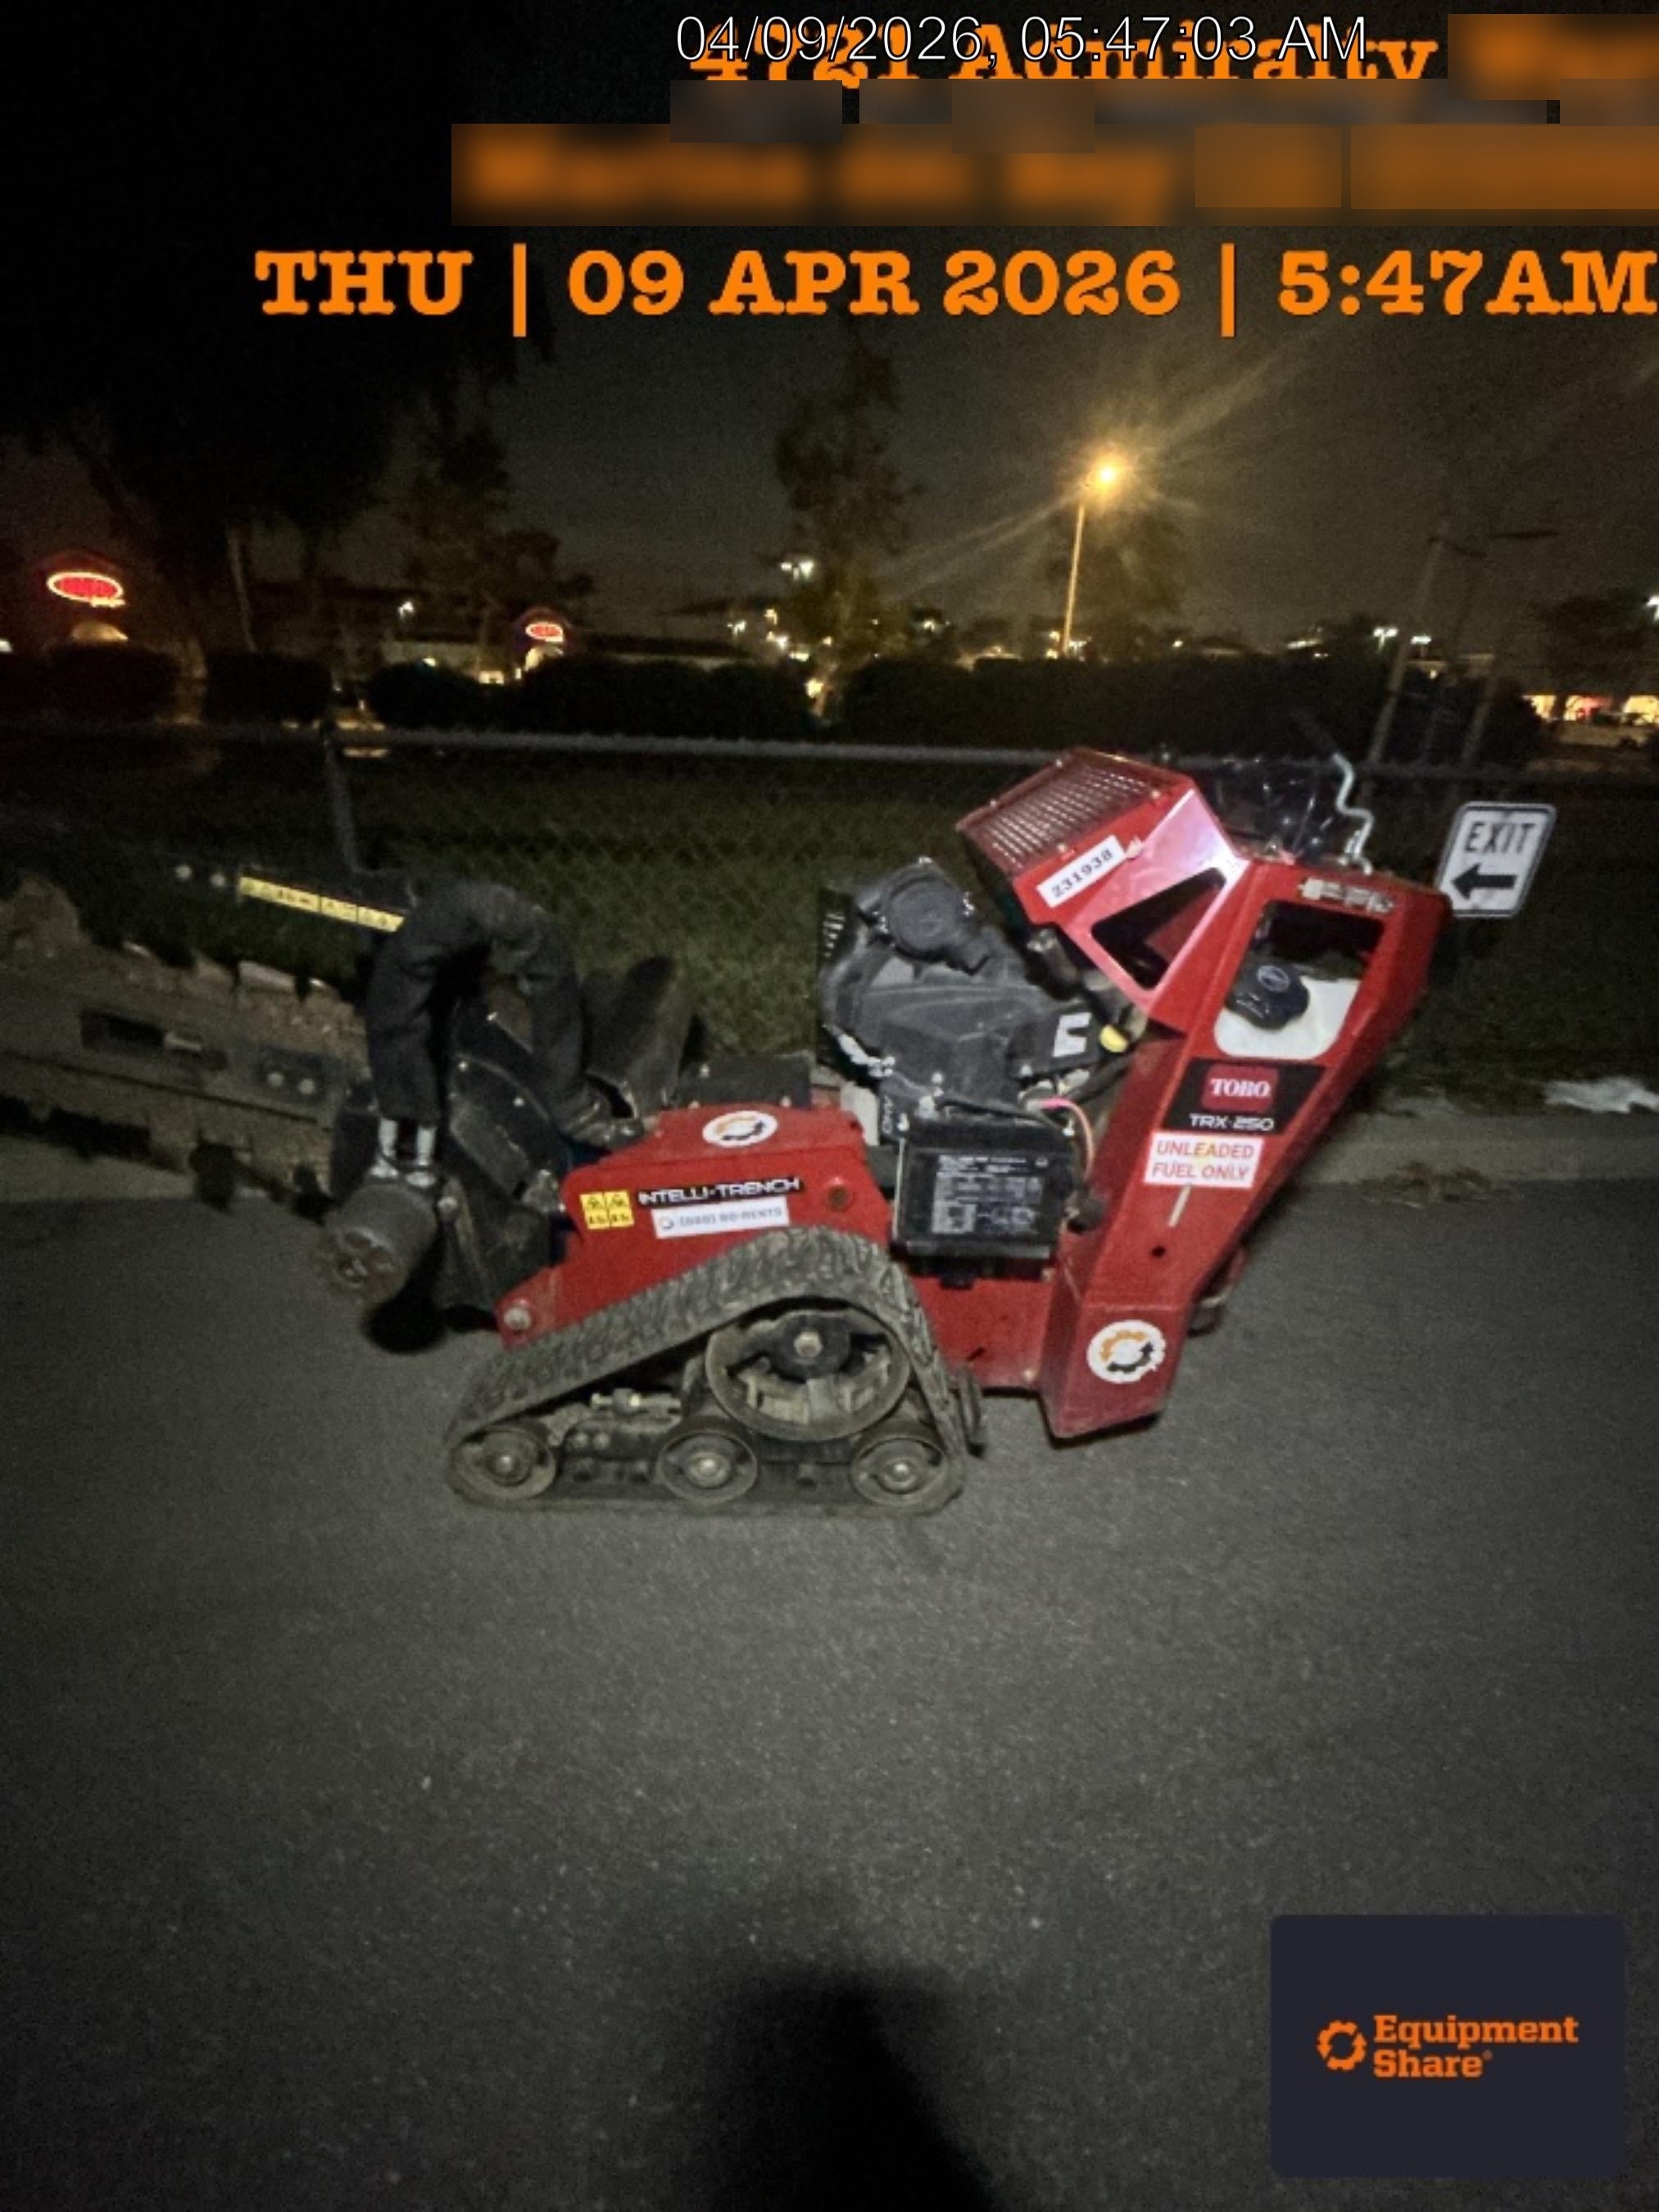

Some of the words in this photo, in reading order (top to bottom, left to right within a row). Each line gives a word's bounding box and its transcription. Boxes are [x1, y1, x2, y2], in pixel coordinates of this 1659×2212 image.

[1464, 821, 1535, 854] EXIT
[1050, 849, 1113, 899] 231938
[1210, 1077, 1271, 1098] TORO
[1157, 1139, 1254, 1158] UNLEADED
[1152, 1162, 1197, 1178] FUEL
[1201, 1163, 1249, 1180] ONLY
